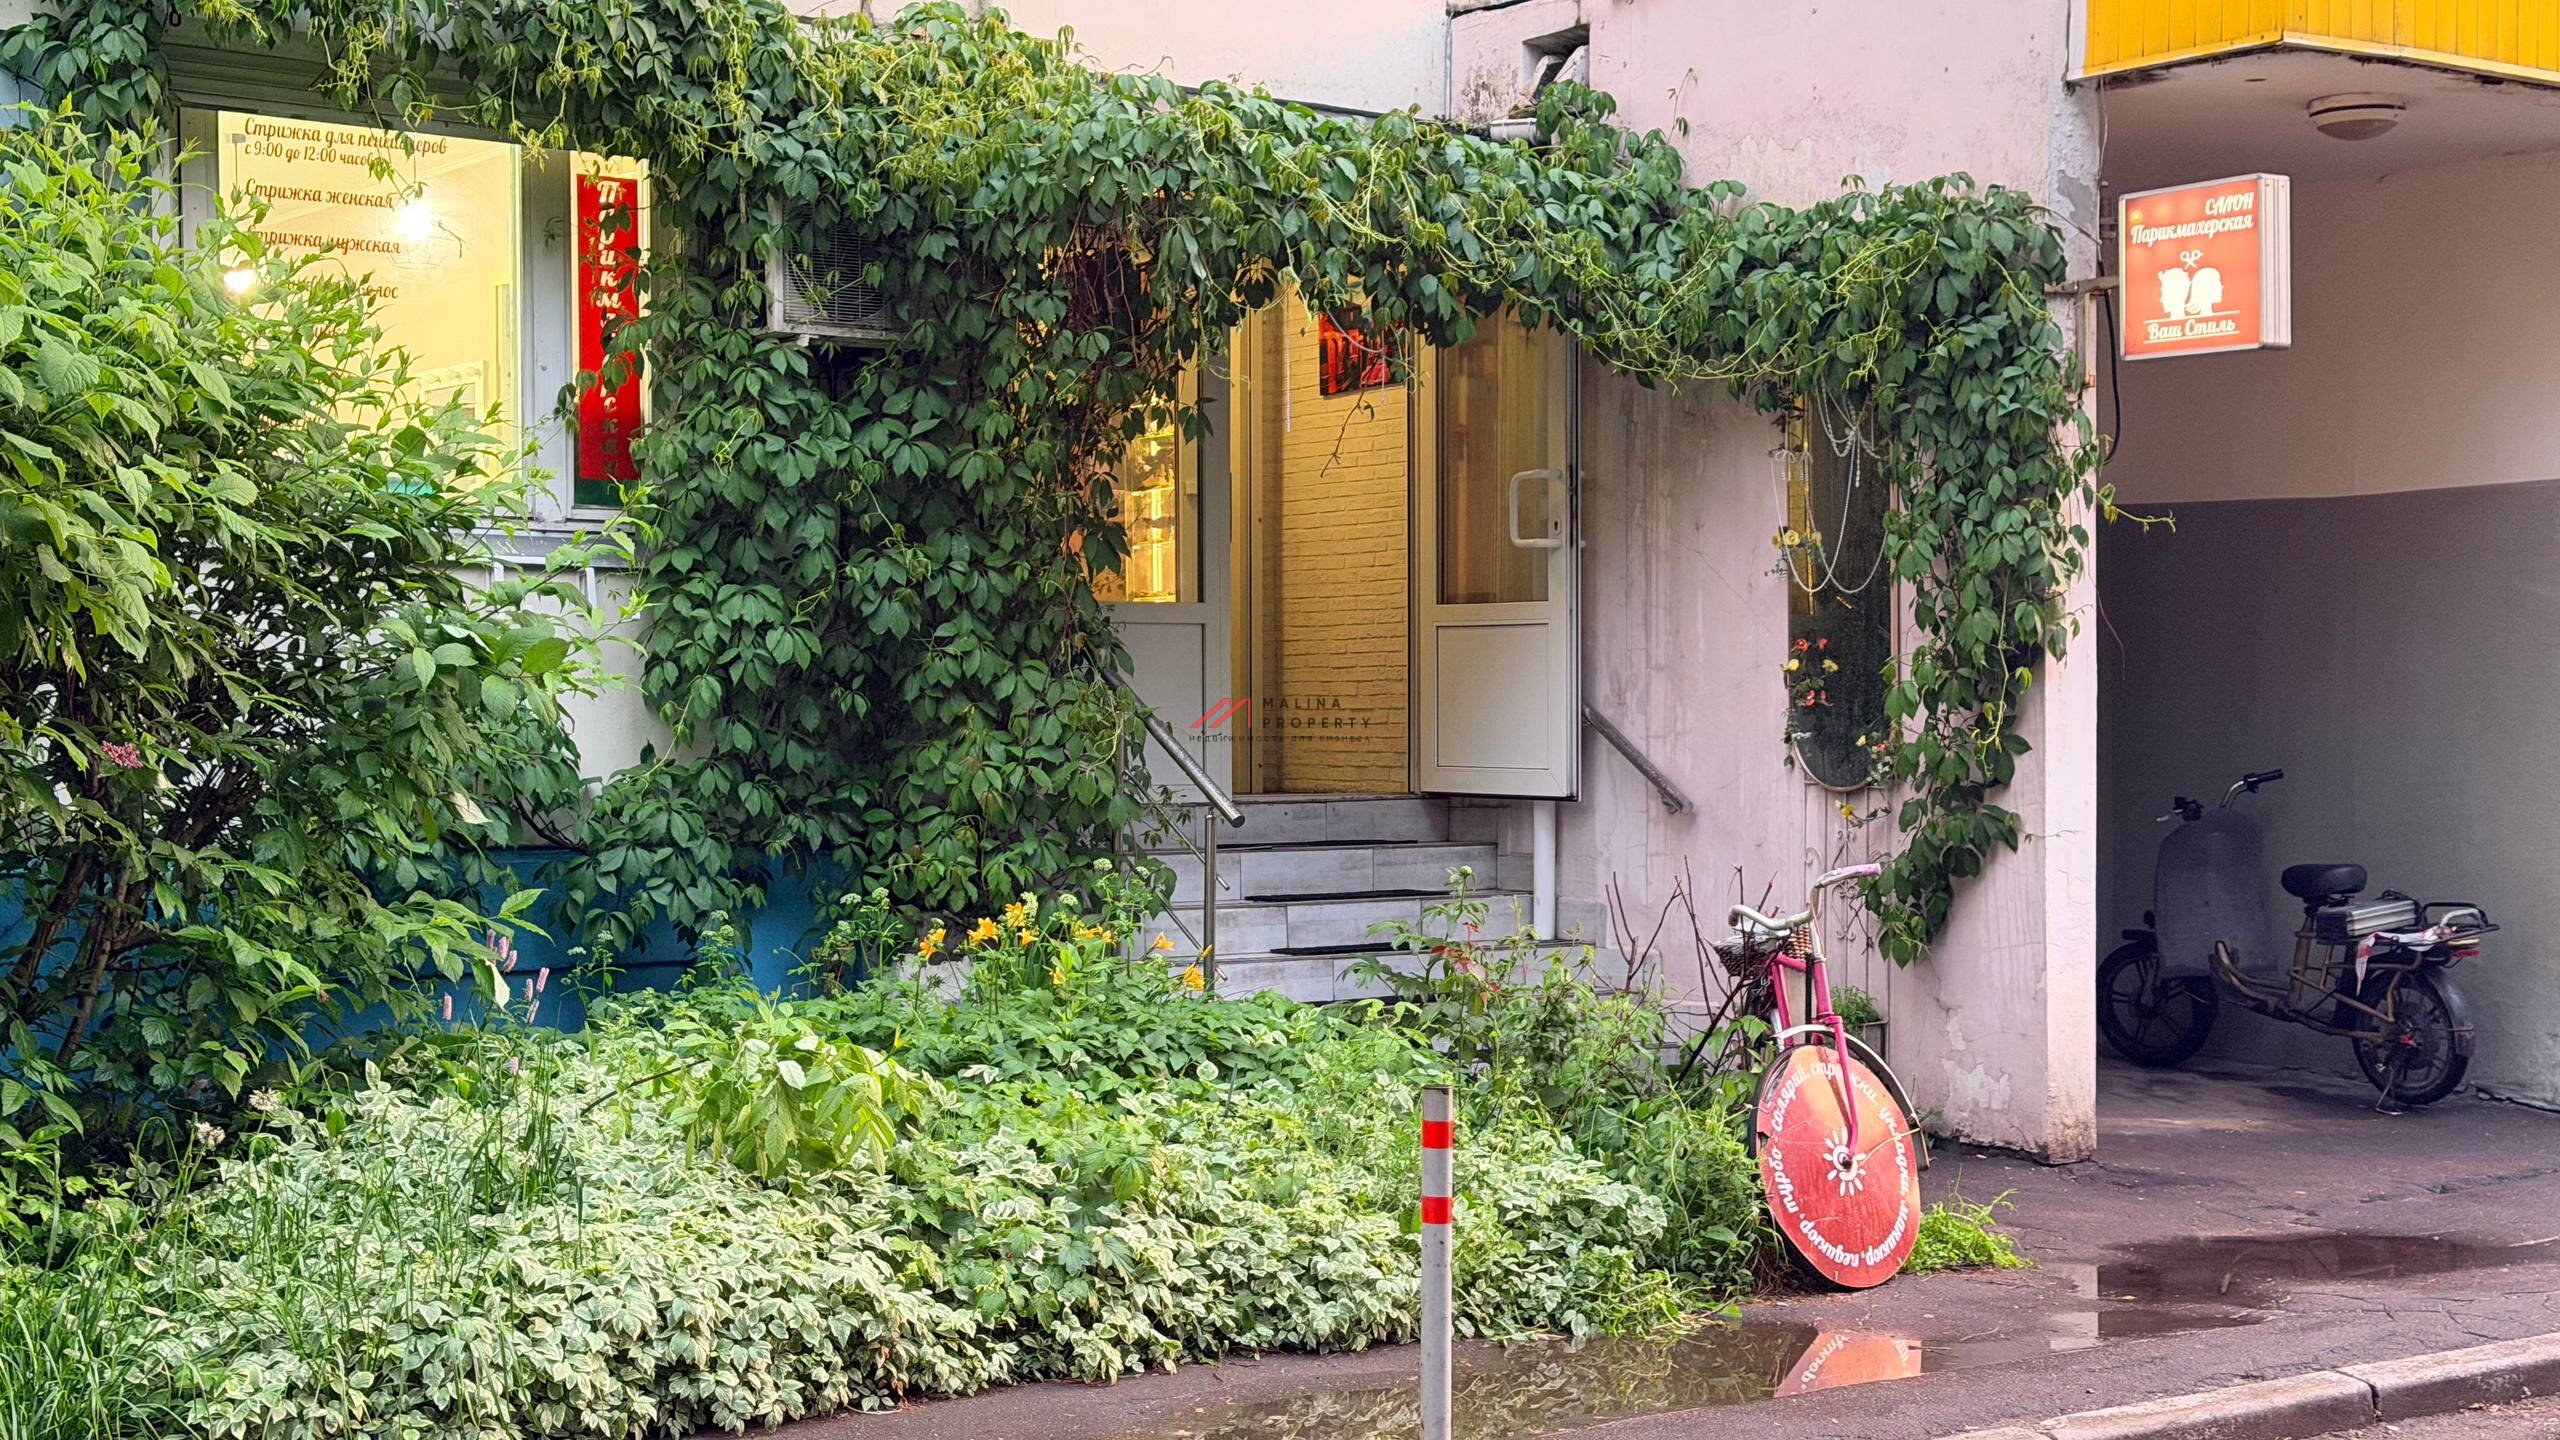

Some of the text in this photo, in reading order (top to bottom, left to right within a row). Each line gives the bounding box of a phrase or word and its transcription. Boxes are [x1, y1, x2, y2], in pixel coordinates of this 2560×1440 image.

[245, 117, 448, 157] Стрижка для пенсиеров
[245, 146, 252, 155] с
[254, 141, 283, 157] 9:00
[285, 148, 300, 163] до
[304, 146, 337, 162] 12:00
[246, 178, 395, 208] Стрижка женская
[2204, 192, 2255, 216] САЛОН
[2130, 214, 2254, 247] Парикмахерская
[360, 285, 399, 299] олос
[2147, 319, 2236, 340] Ваш Стиль
